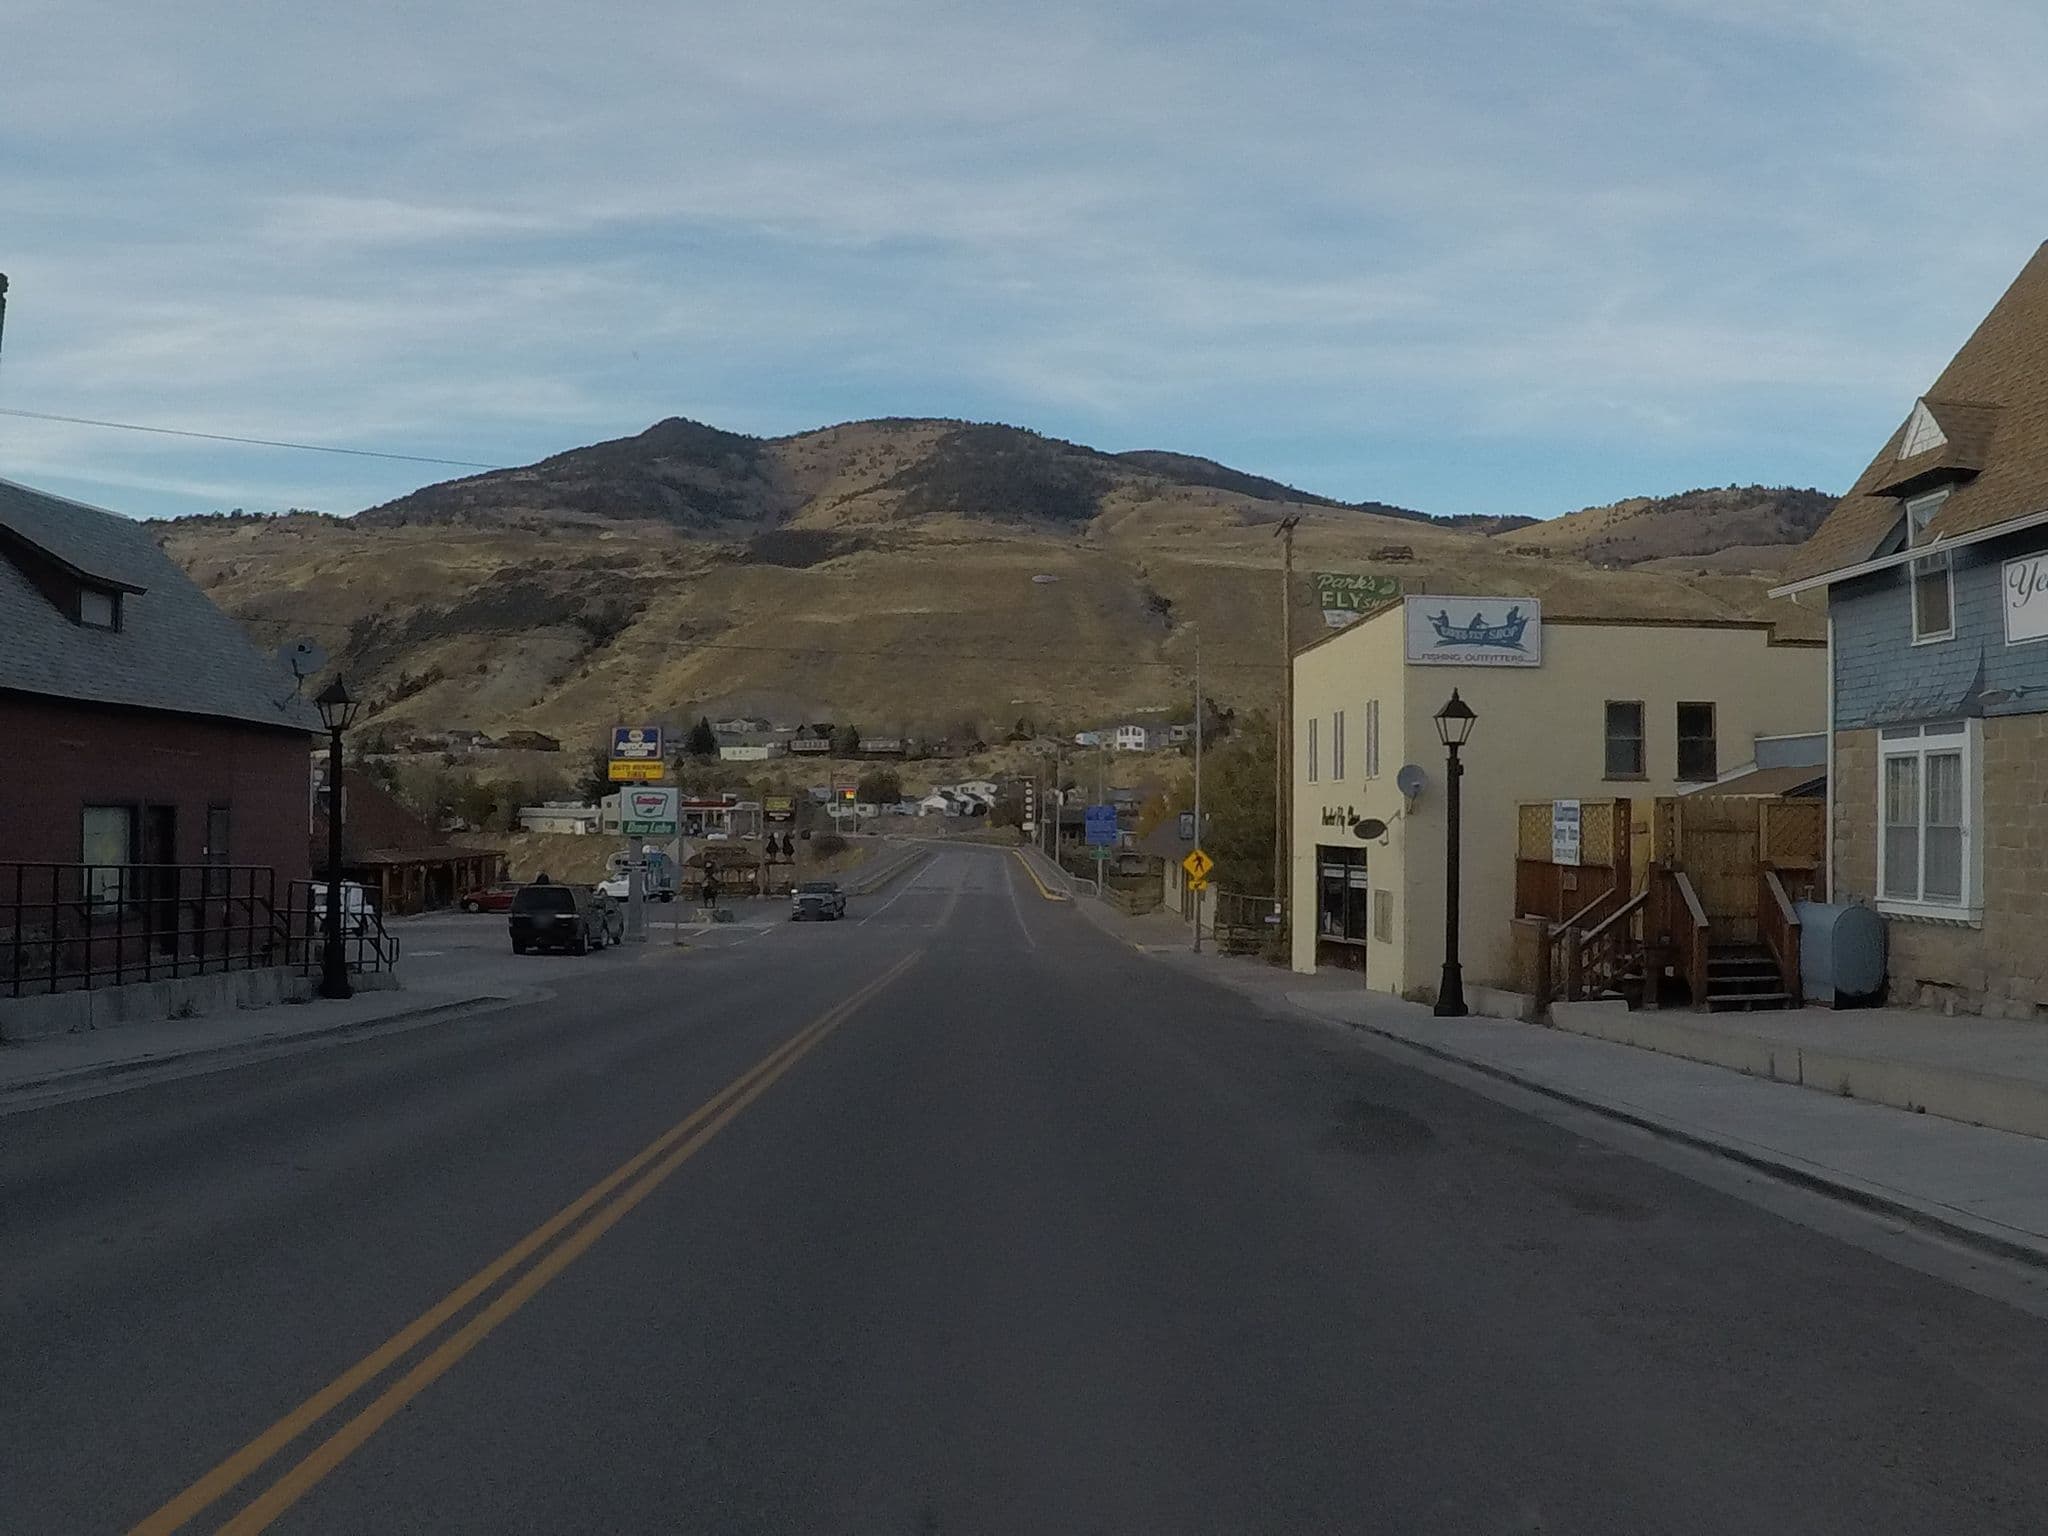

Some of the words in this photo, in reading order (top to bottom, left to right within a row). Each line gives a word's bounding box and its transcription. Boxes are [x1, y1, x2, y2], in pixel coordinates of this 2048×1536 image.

[1321, 591, 1363, 608] FLY
[1487, 625, 1519, 640] SHOP
[1464, 653, 1525, 663] OUTFITTERS
